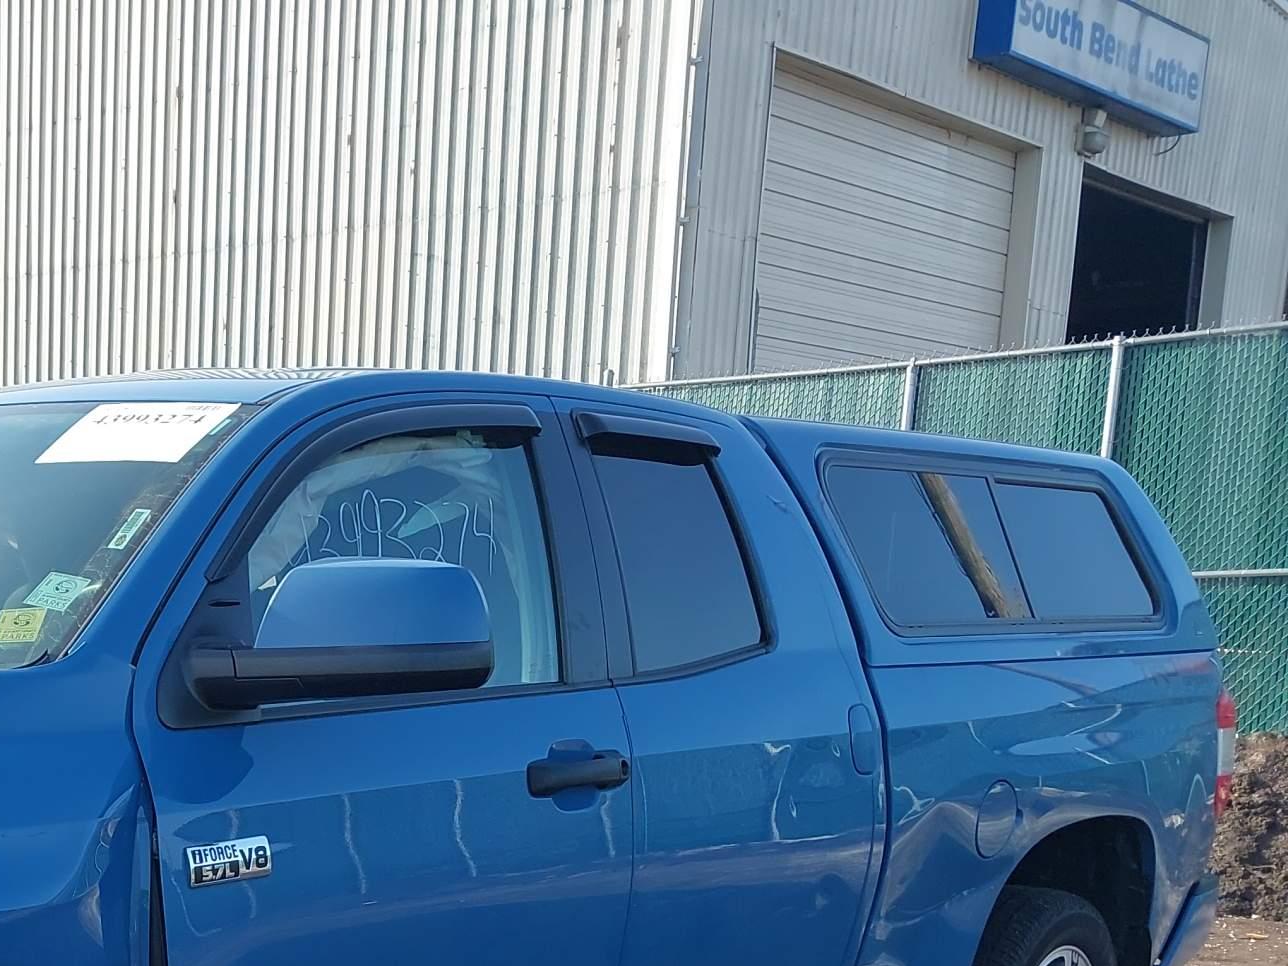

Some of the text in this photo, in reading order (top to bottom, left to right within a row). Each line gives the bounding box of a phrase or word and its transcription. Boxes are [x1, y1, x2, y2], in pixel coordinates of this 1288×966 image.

[1018, 0, 1199, 100] South Bend Lathe
[37, 597, 68, 608] PARKS
[1, 632, 35, 640] PARKS
[239, 845, 269, 871] V8
[202, 862, 236, 881] 5.7L
